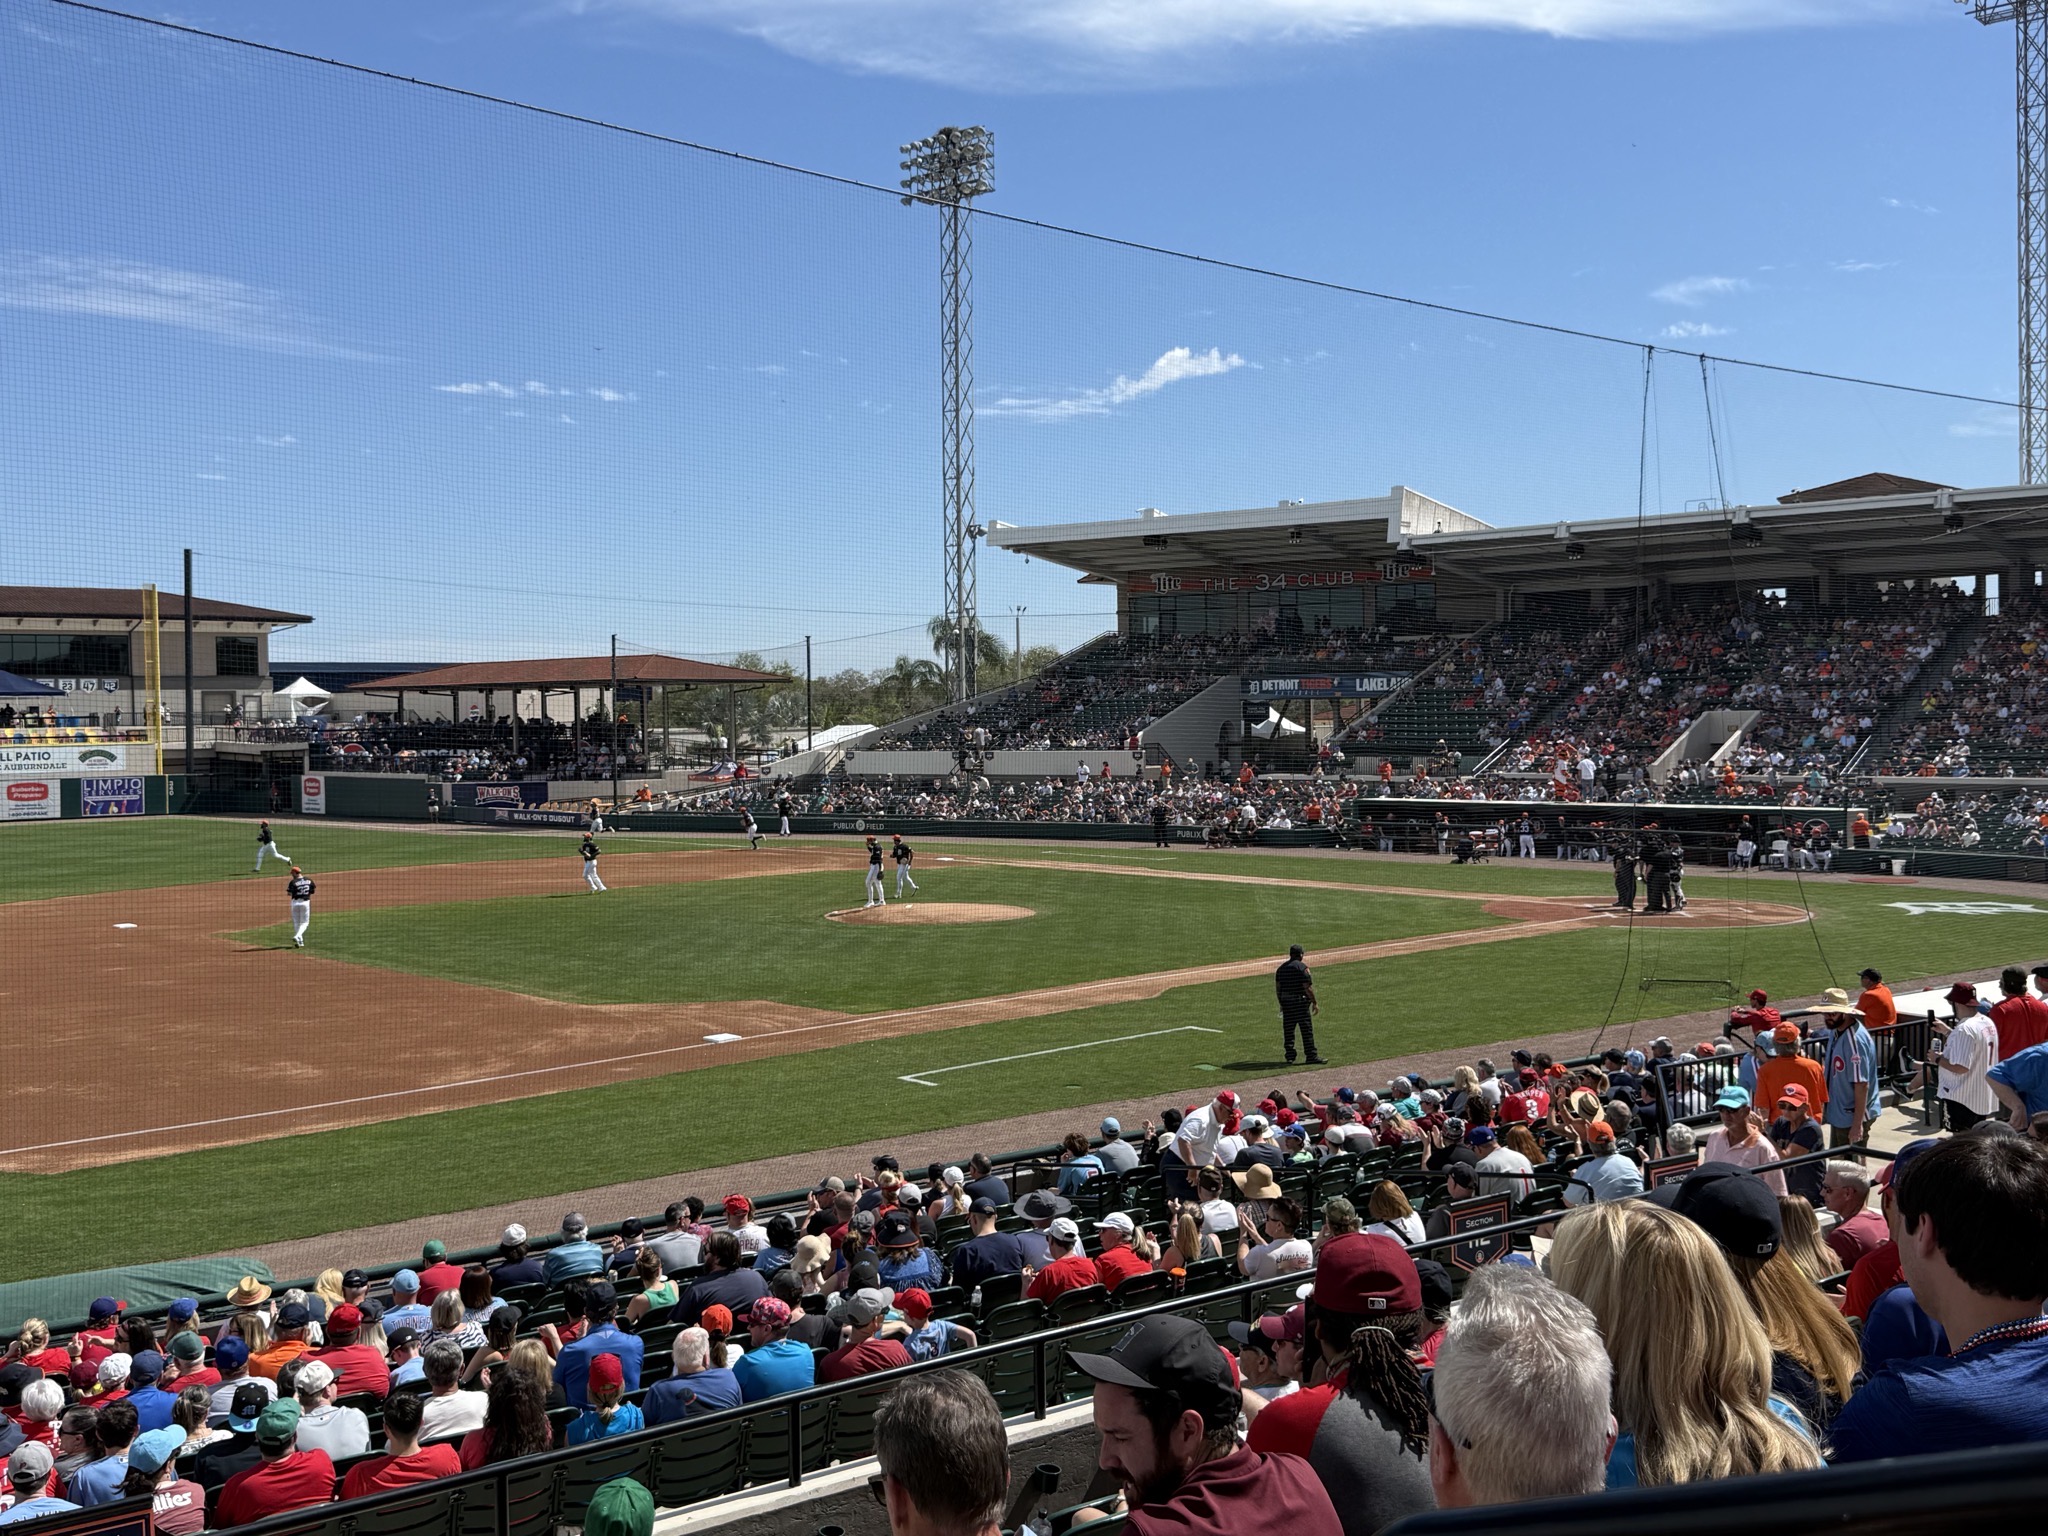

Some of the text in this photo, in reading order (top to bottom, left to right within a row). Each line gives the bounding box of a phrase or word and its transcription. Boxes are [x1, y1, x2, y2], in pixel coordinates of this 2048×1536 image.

[1376, 560, 1410, 582] Lite
[1150, 573, 1181, 594] Lite
[1200, 577, 1239, 592] THE
[1298, 571, 1354, 587] CLUB
[83, 682, 95, 691] 47
[105, 682, 115, 690] 42
[1262, 677, 1333, 691] DETROIT TIGERS
[1356, 677, 1412, 691] LAKELA
[16, 752, 51, 761] PATIO
[84, 778, 141, 790] LIMPIO
[549, 814, 575, 823] DUGOUT
[1176, 830, 1201, 838] PUBLIX
[1525, 1099, 1539, 1119] 3
[152, 1492, 192, 1513] illies
